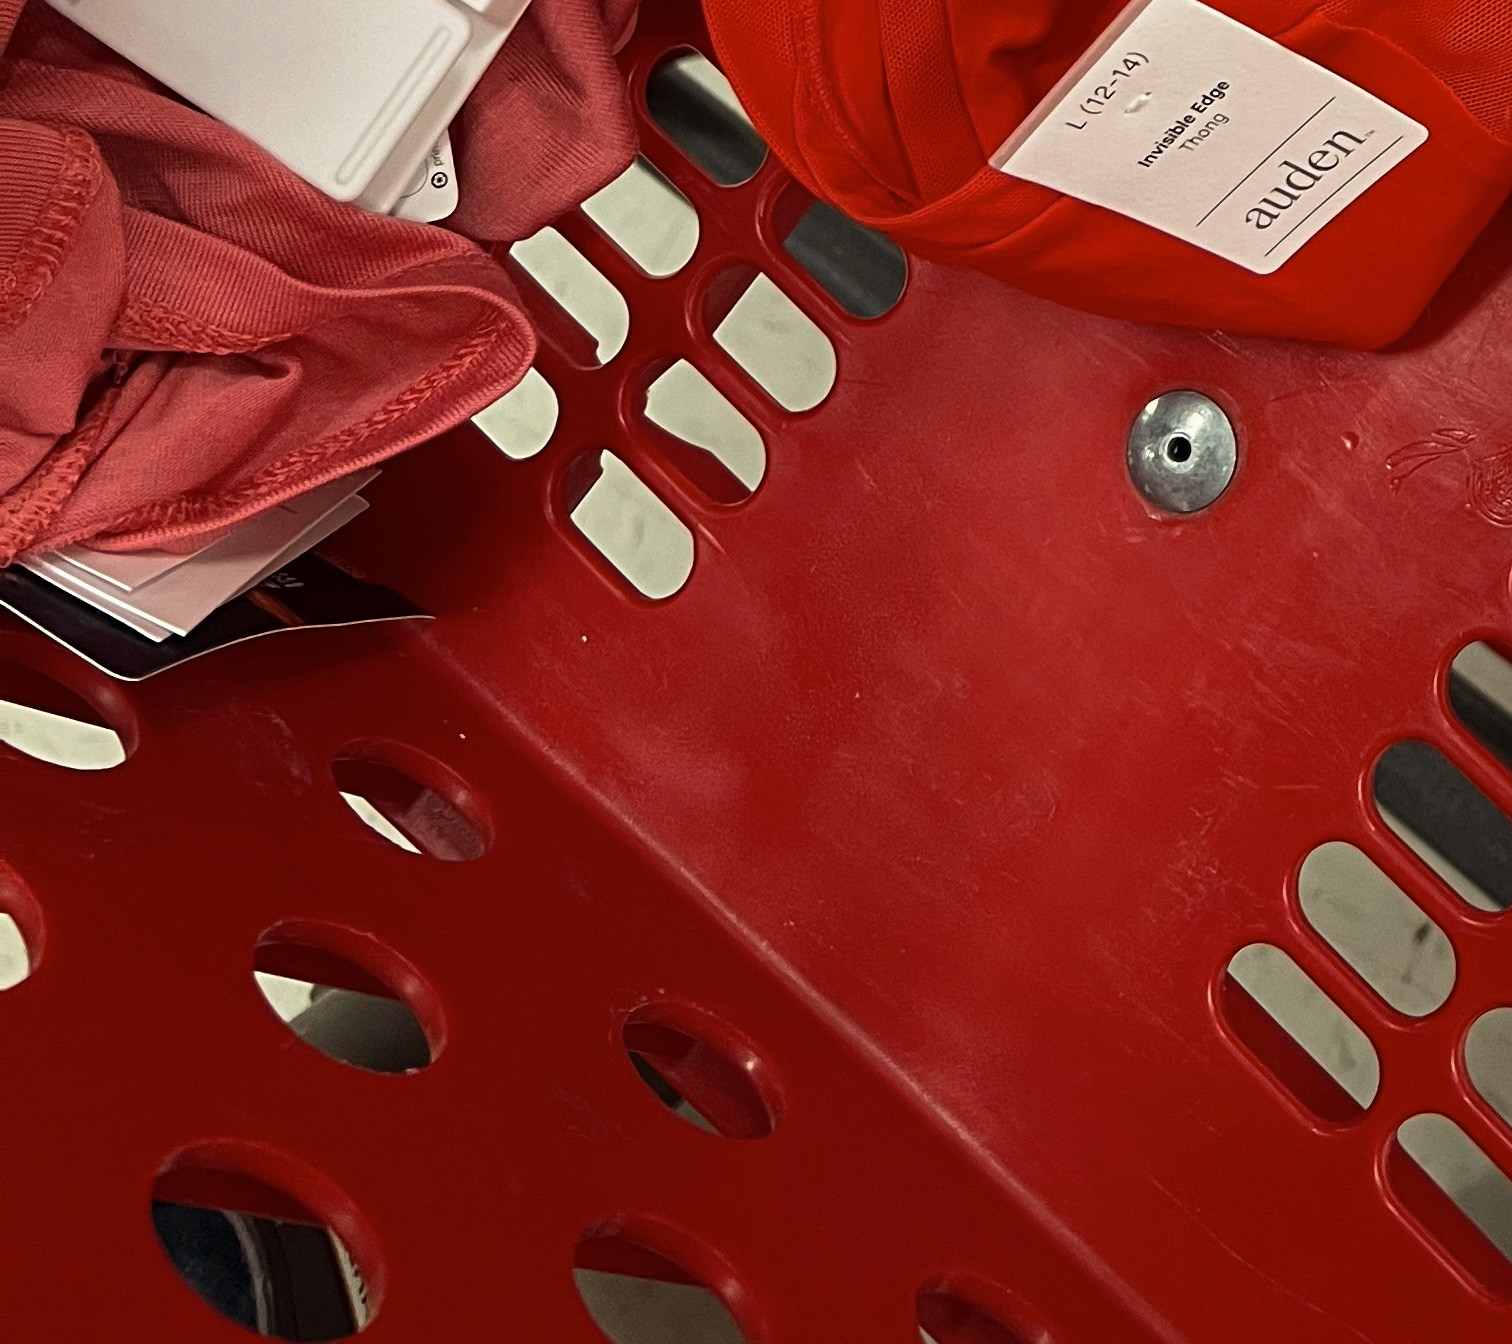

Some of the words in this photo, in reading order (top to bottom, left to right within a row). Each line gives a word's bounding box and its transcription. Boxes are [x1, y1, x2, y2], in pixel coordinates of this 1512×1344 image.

[1065, 116, 1088, 131] L
[1079, 50, 1151, 115] (12-14)
[1137, 111, 1196, 169] Invisible
[1190, 78, 1231, 114] Edge
[1178, 112, 1231, 154] Thong
[1244, 128, 1368, 231] auden
